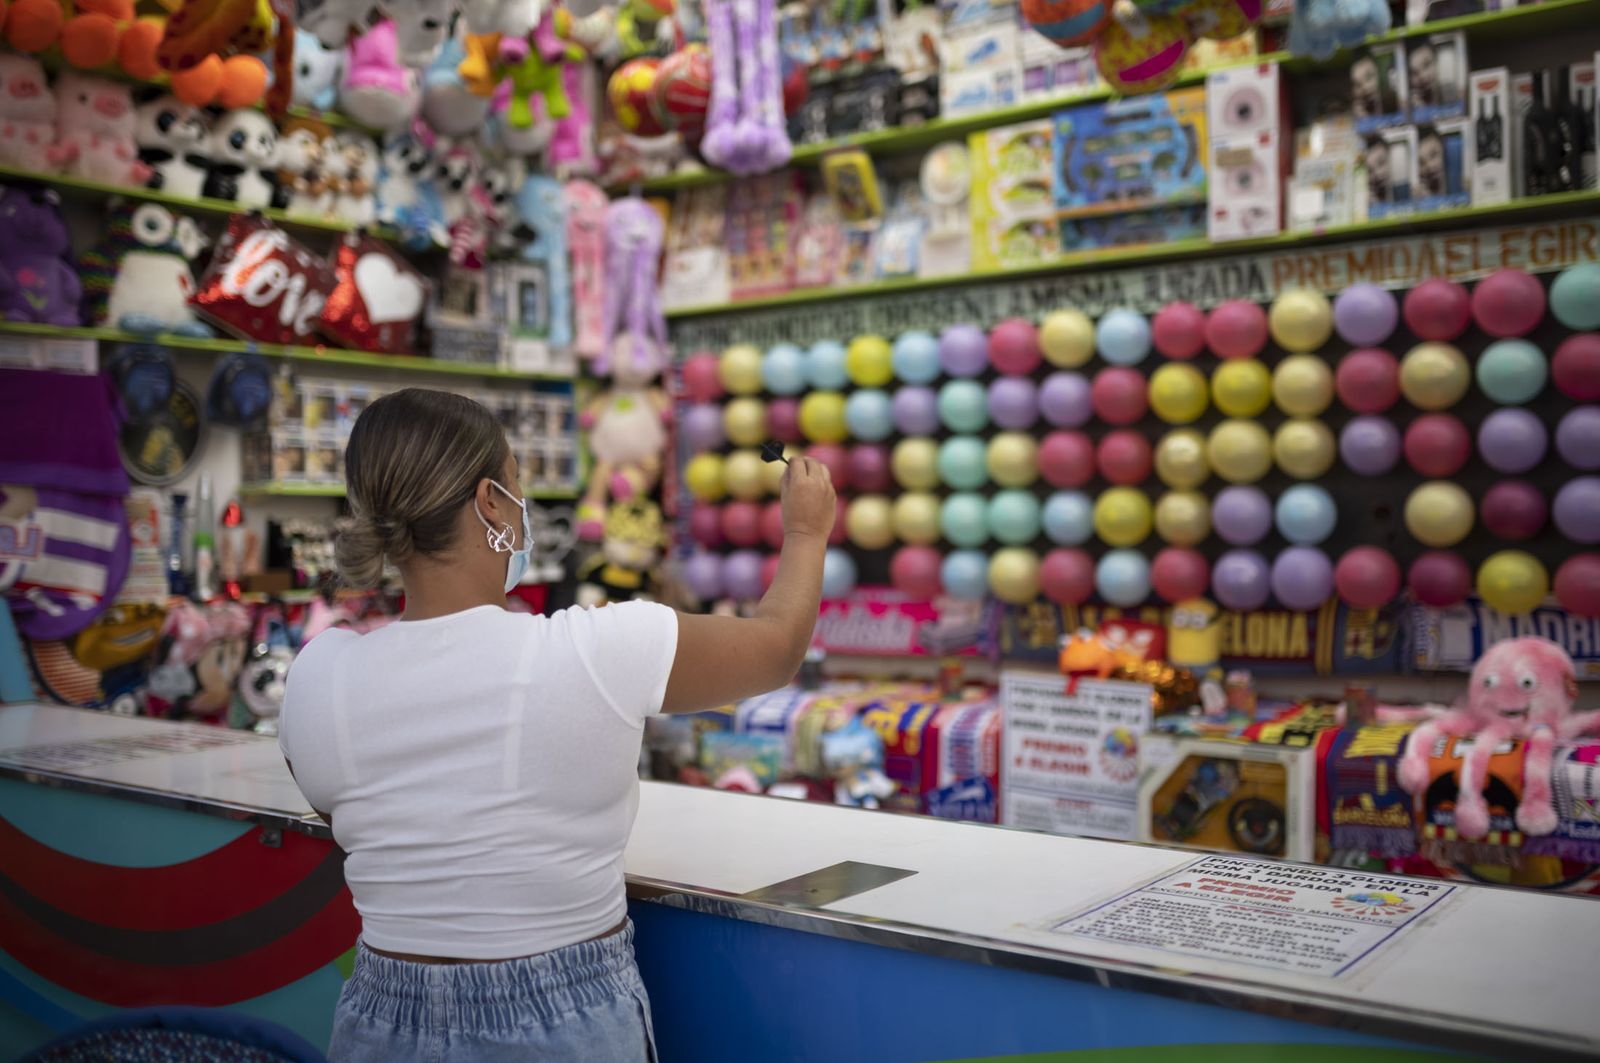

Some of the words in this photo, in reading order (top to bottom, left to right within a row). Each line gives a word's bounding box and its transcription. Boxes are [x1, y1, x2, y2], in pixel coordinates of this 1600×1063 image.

[1187, 868, 1252, 881] MISMA
[1257, 879, 1343, 894] JUGADA
[1197, 877, 1297, 896] PREMIO
[1200, 862, 1244, 872] CON
[1266, 871, 1356, 888] DARDOS,
[1364, 884, 1396, 892] EN
[1401, 888, 1430, 897] LA
[1210, 858, 1327, 877] PINCHANDO
[1351, 876, 1440, 891] GLOBOS
[1198, 884, 1294, 903] ELEGIR
